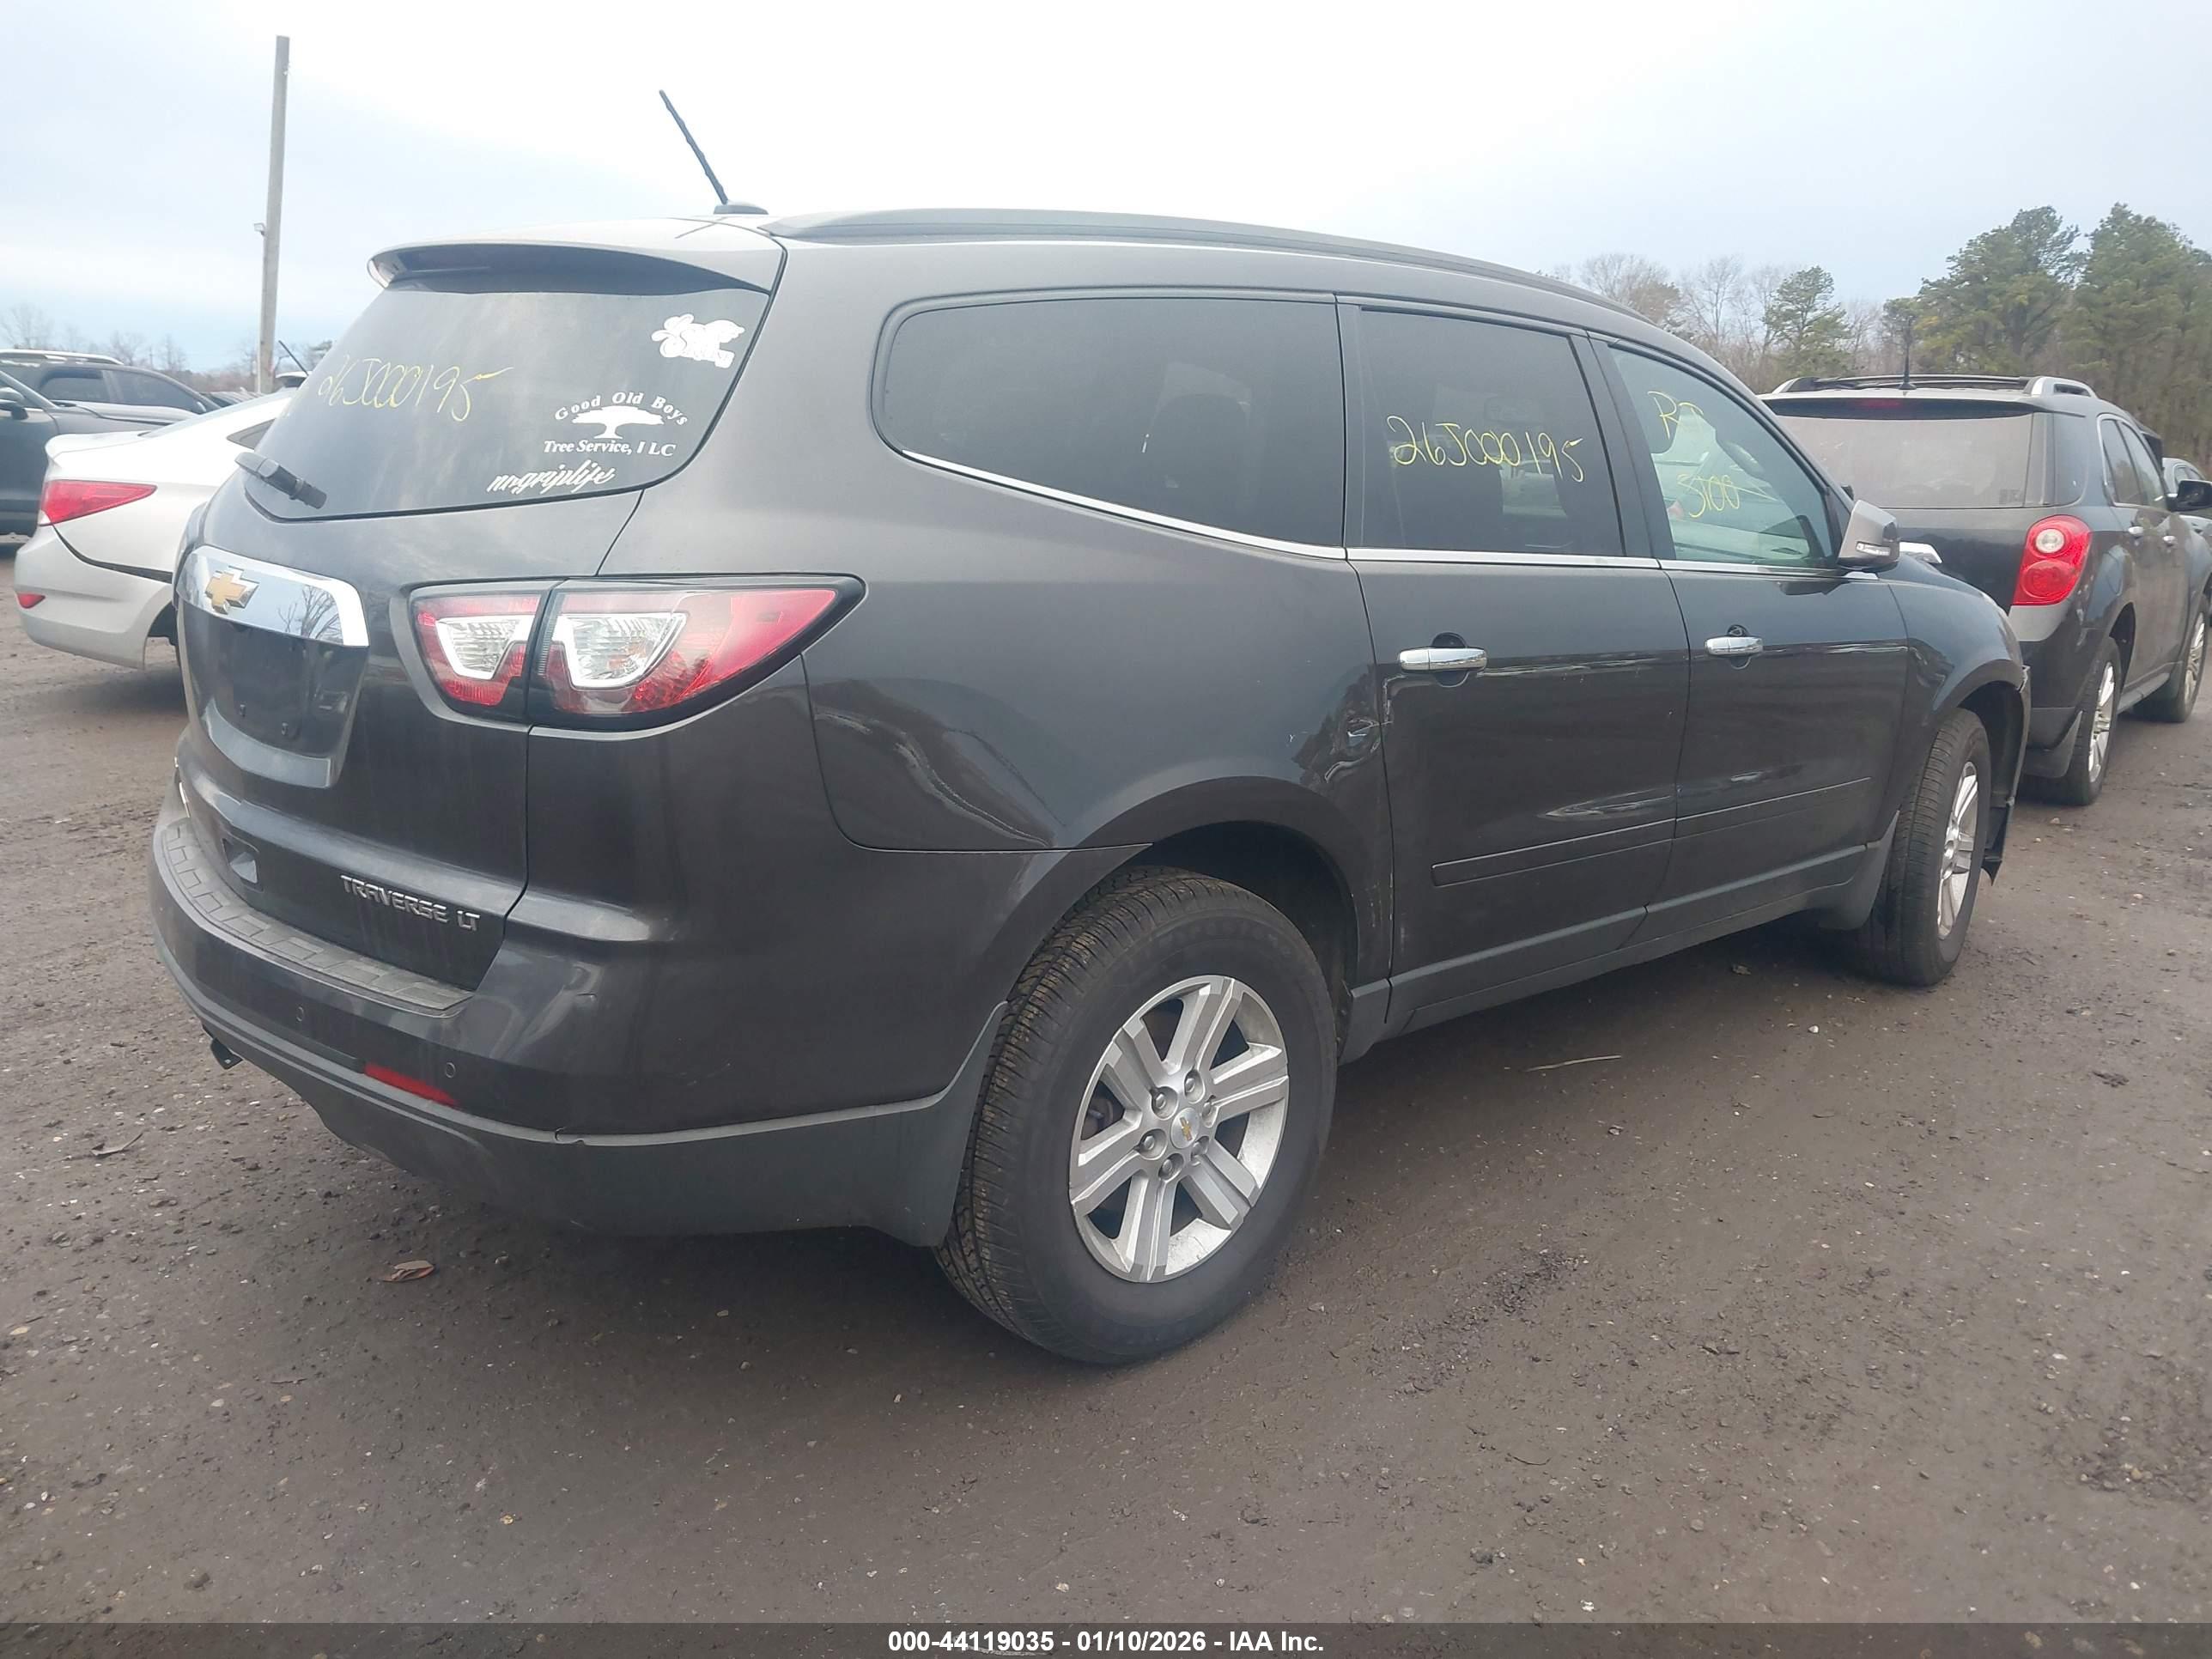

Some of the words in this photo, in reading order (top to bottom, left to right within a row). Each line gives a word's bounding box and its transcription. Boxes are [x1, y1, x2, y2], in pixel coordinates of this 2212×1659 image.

[554, 395, 602, 421] Good
[611, 392, 645, 404] Old
[650, 396, 688, 426] Boys
[544, 440, 575, 453] Tree
[575, 439, 633, 455] Service,
[1386, 415, 1584, 483] 26J000195
[341, 875, 449, 923] TRAVERSE
[457, 910, 480, 931] LT
